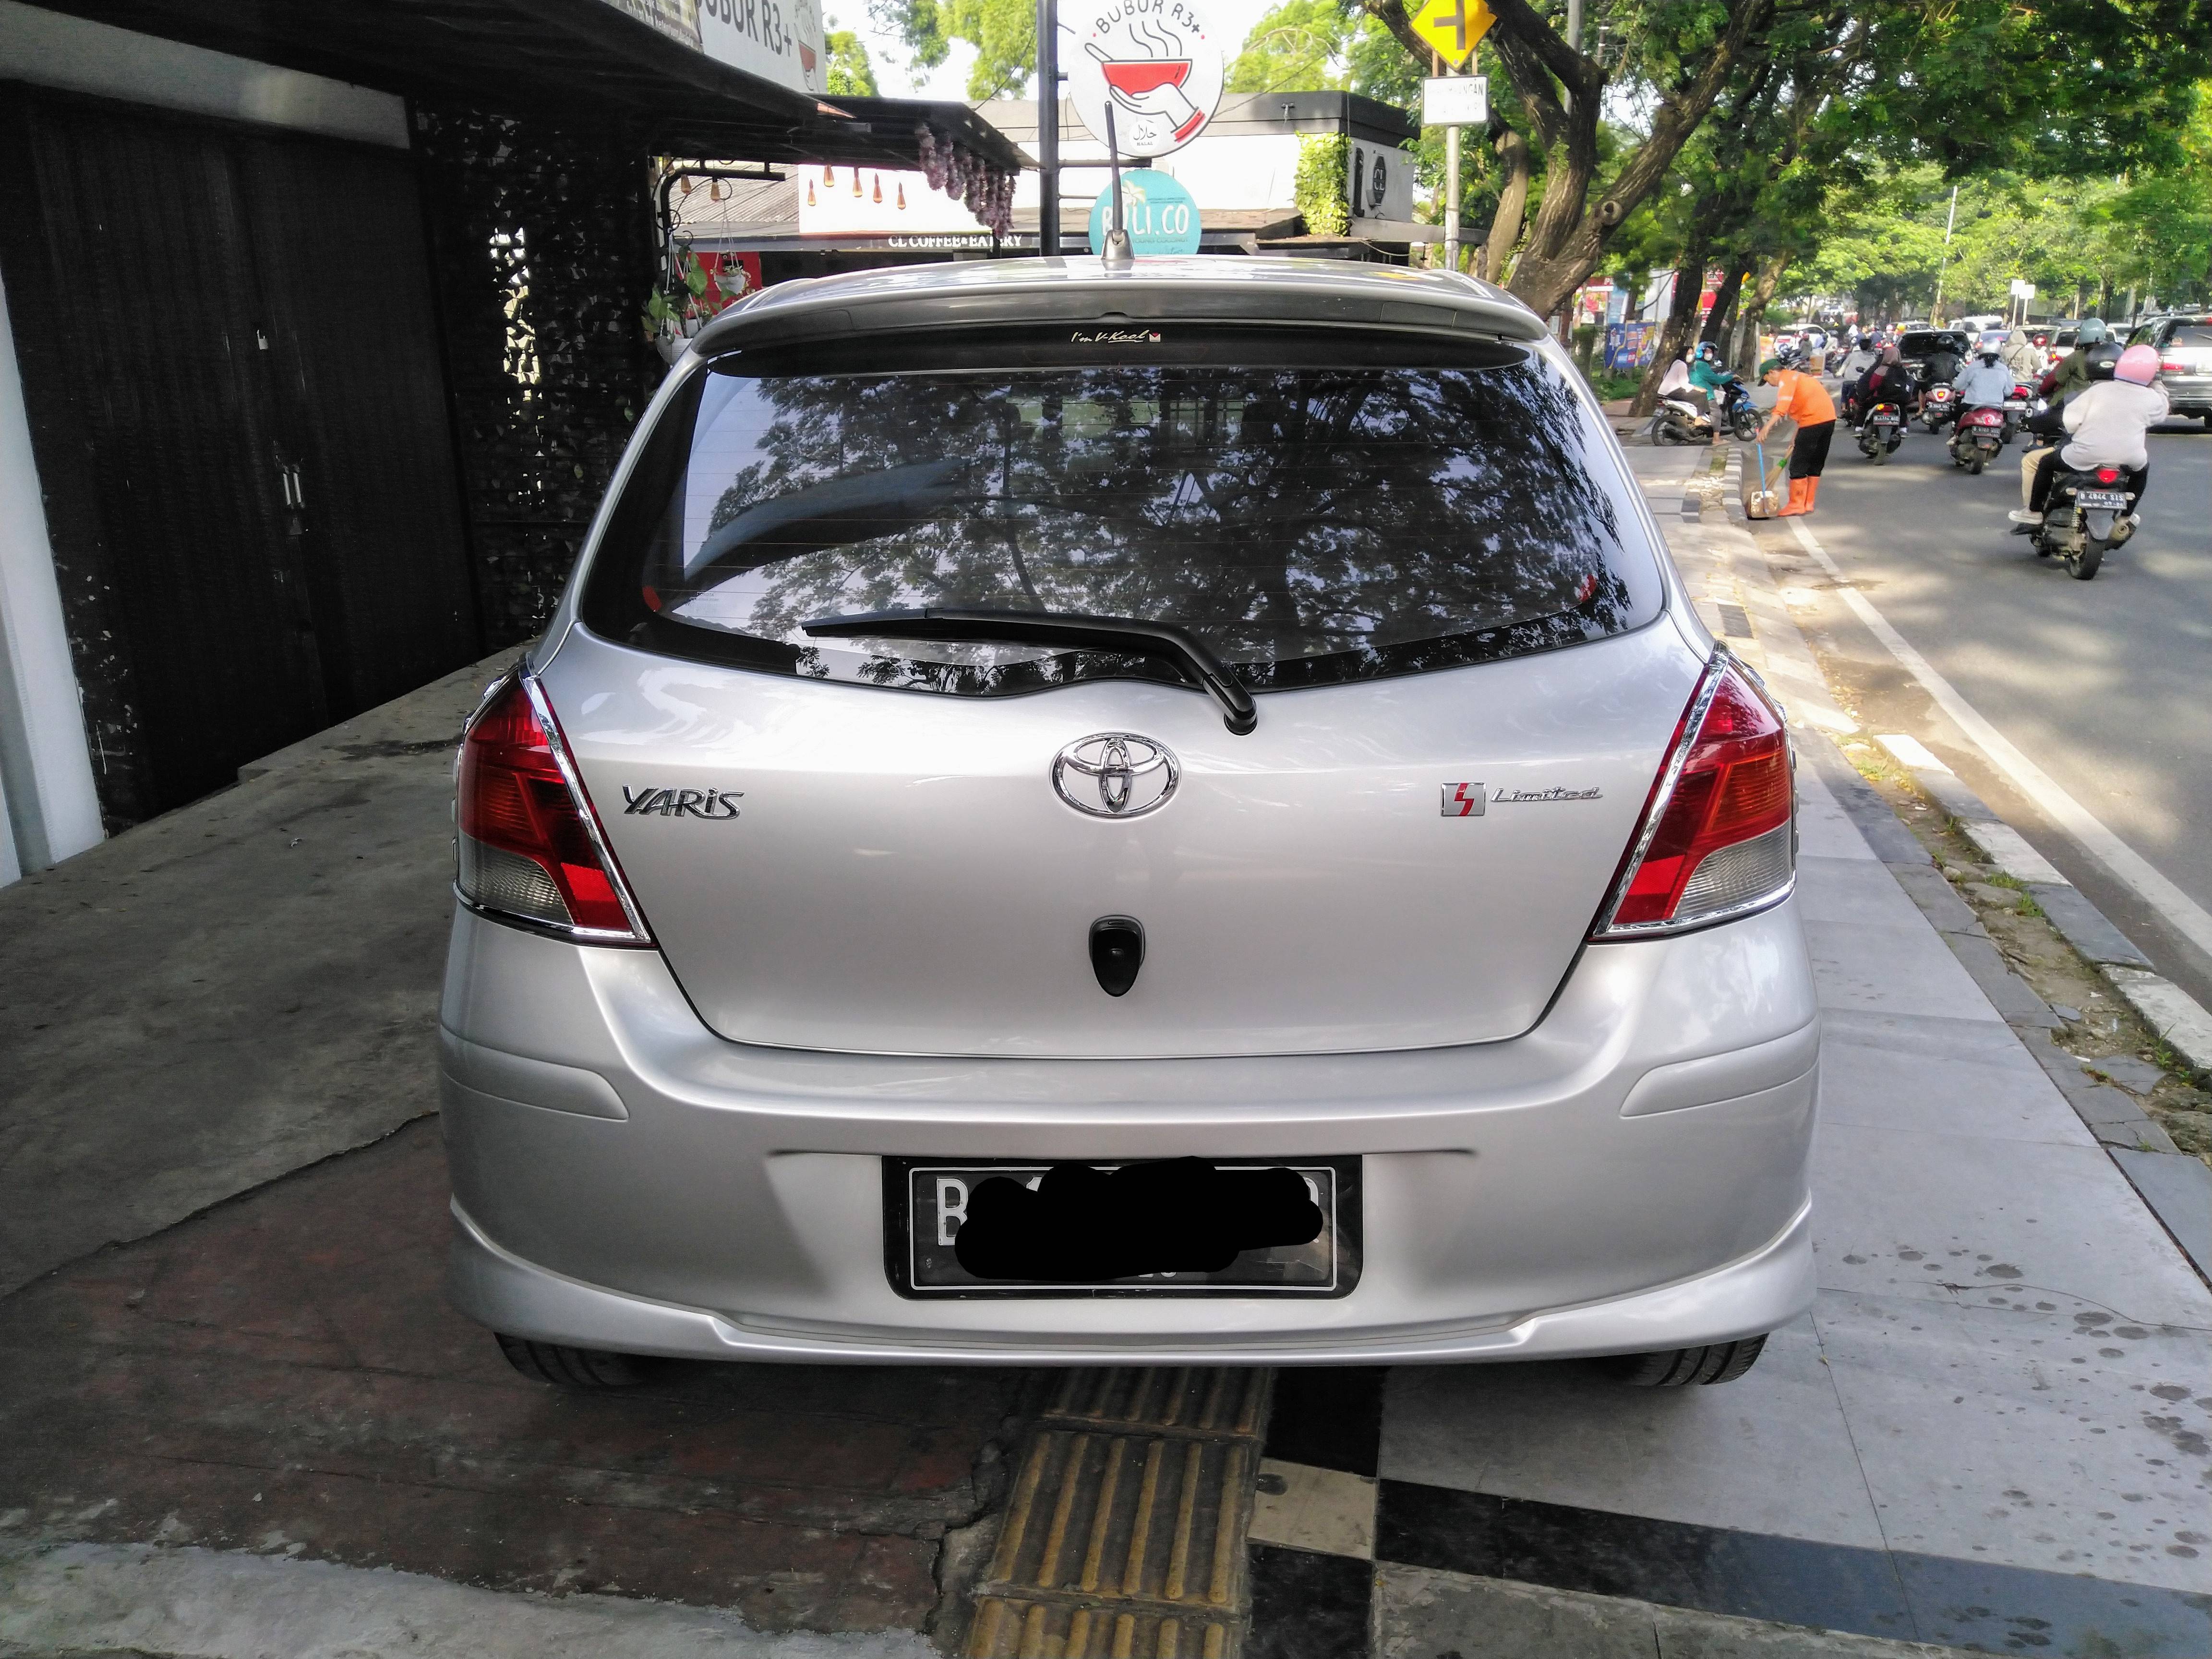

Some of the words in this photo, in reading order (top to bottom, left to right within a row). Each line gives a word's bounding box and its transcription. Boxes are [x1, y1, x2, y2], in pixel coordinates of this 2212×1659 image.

[1096, 0, 1164, 34] BUBUR
[1171, 3, 1200, 33] R3+
[761, 0, 792, 57] R3+
[888, 235, 907, 248] CL
[1071, 332, 1092, 342] I'm
[1094, 329, 1150, 343] V-Kool
[1490, 786, 1605, 803] Limited
